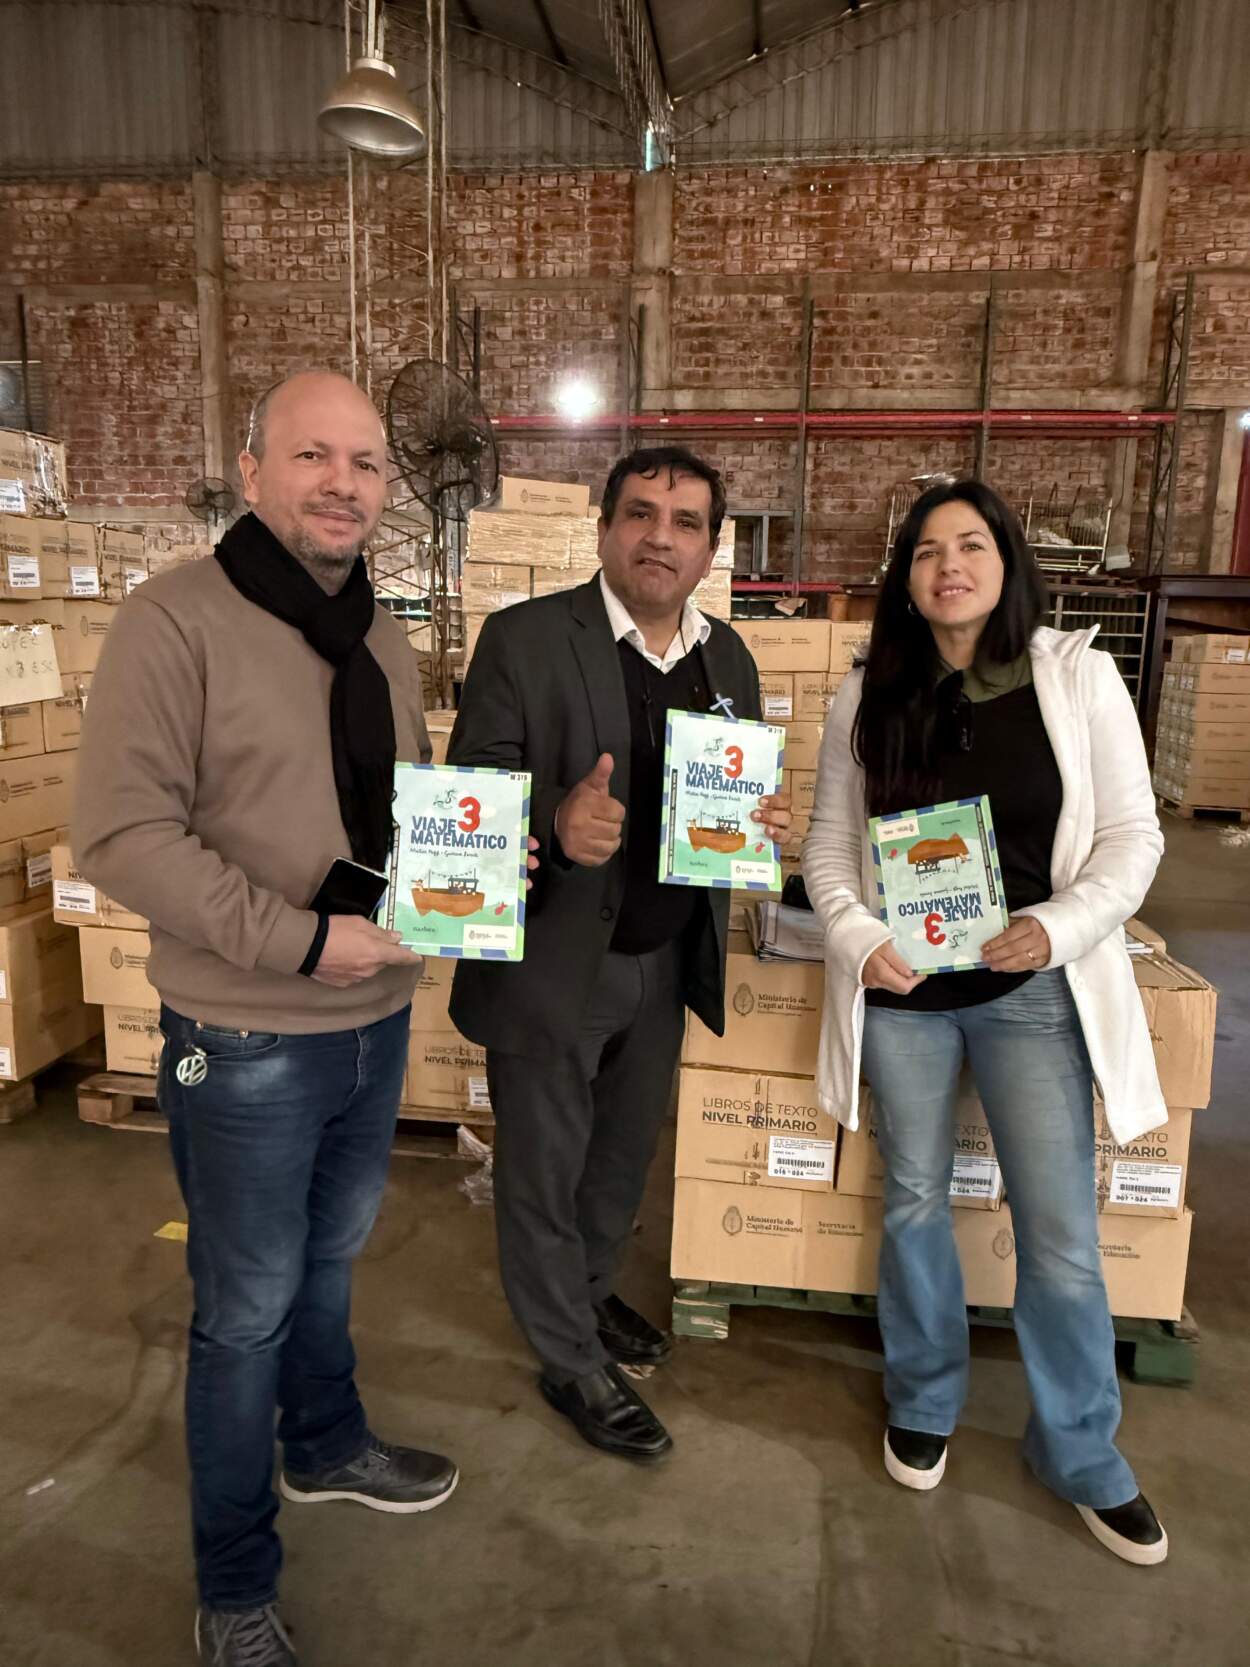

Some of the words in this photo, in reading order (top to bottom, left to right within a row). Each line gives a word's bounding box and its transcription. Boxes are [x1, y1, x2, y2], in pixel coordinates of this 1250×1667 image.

[686, 760, 723, 780] VIAJE
[723, 745, 744, 779] 3
[412, 816, 457, 836] VIAJE
[457, 796, 481, 833] 3
[944, 902, 984, 923] VIAJE
[924, 912, 947, 946] 3
[425, 1055, 452, 1065] NIVEL
[703, 1097, 751, 1112] LIBROS
[754, 1101, 773, 1114] DE
[778, 1104, 818, 1118] TEXTO
[702, 1111, 743, 1125] NIVEL
[746, 1115, 817, 1132] PRIMARIO
[1095, 1144, 1167, 1158] PRIMARIO
